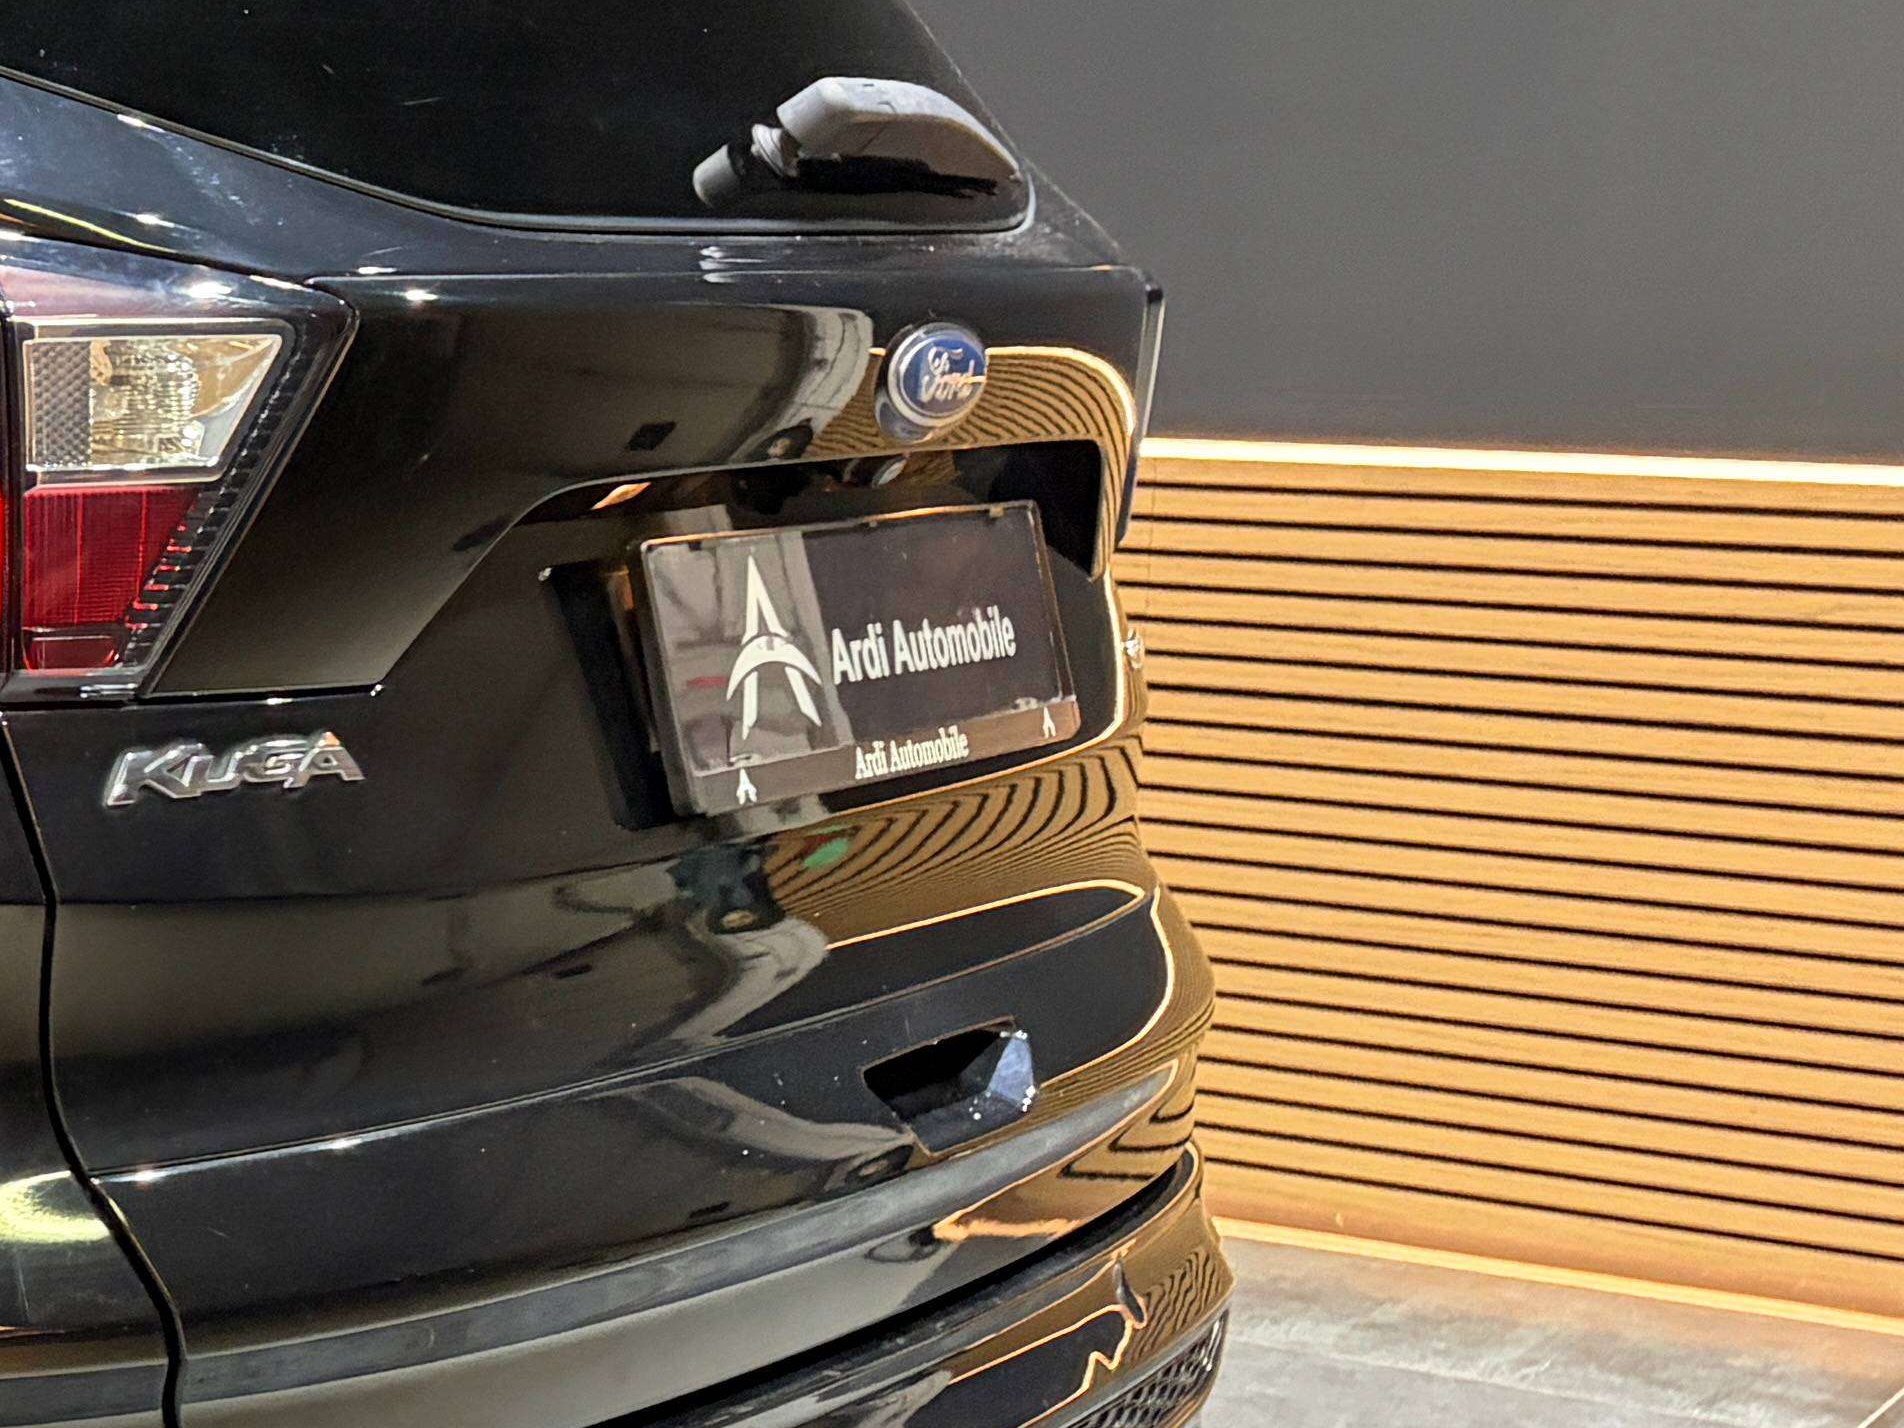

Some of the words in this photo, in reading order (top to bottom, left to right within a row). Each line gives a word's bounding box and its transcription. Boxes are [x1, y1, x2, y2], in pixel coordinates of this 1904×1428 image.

[917, 346, 976, 403] Ford
[831, 622, 890, 685] Ardi
[893, 604, 1017, 675] Automobile
[104, 729, 366, 809] KUGA
[854, 740, 889, 780] Ardi
[890, 724, 970, 773] Automobile
